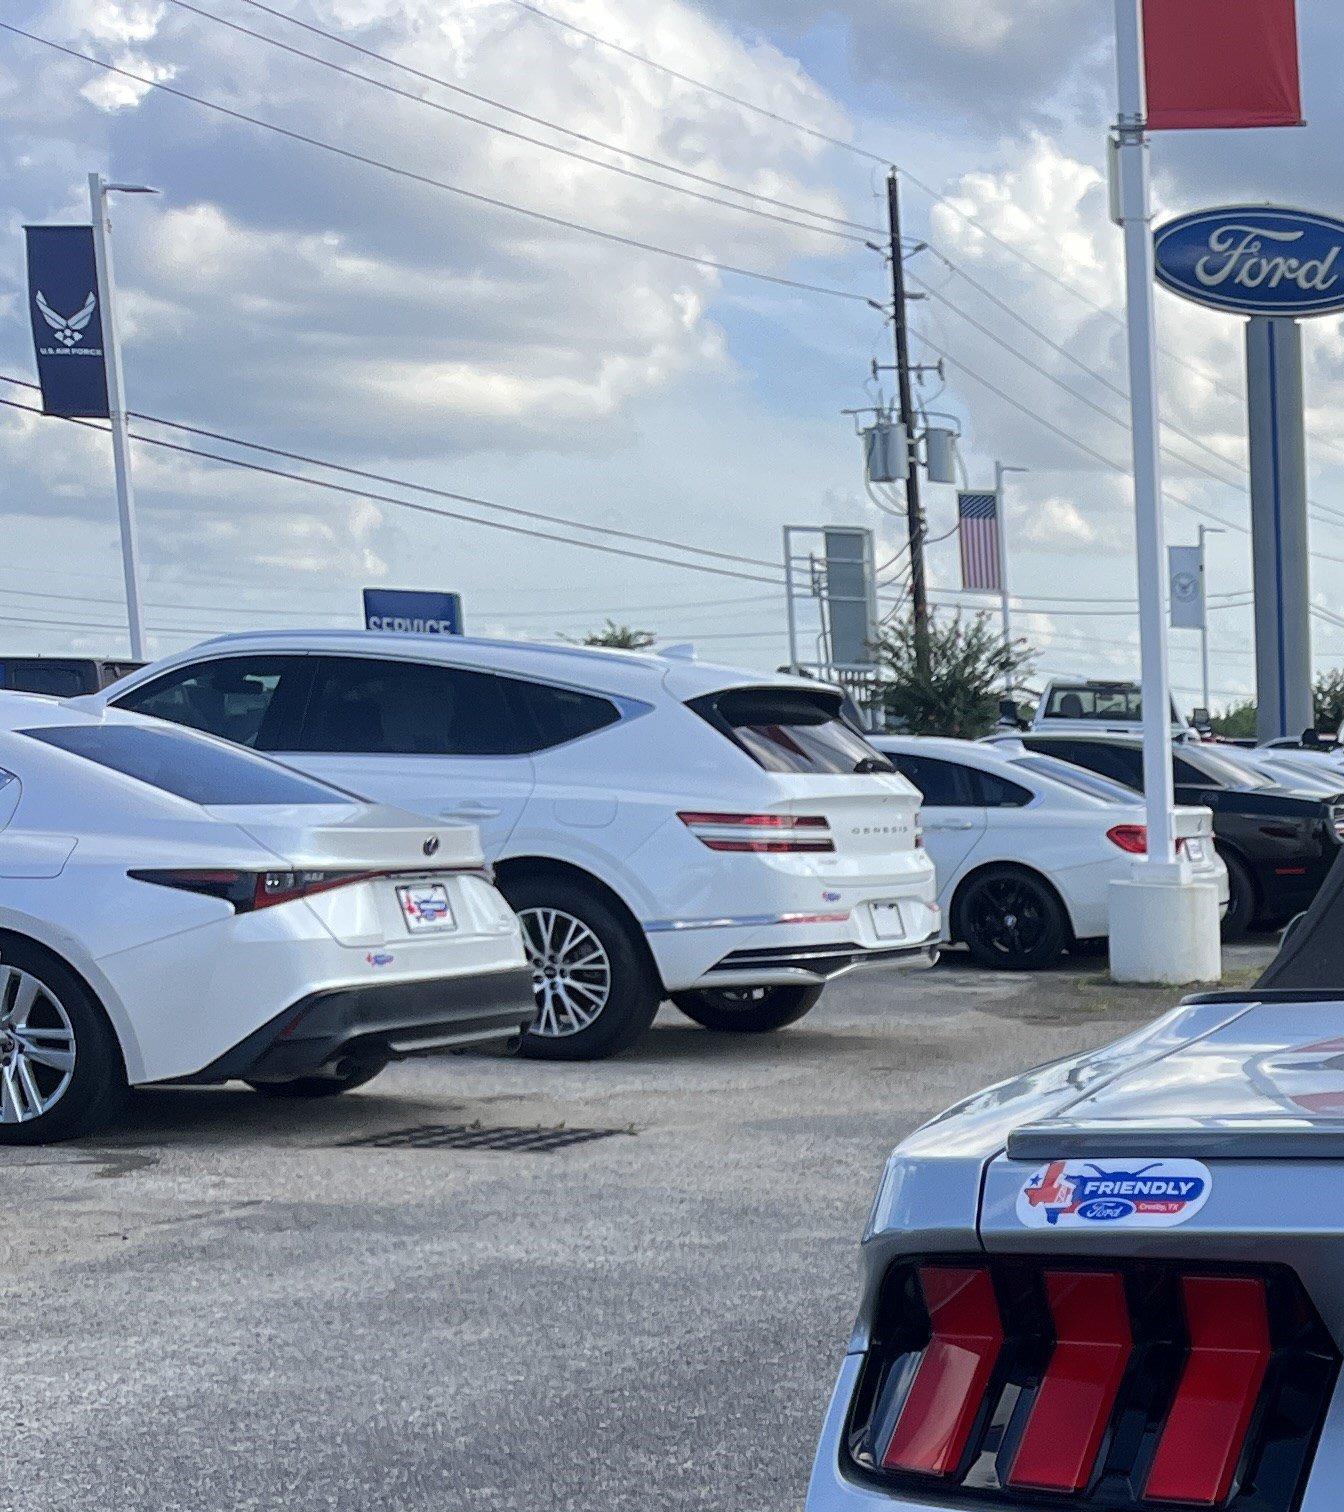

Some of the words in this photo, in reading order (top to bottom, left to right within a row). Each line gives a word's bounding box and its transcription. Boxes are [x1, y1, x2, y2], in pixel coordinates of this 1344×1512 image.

[1195, 224, 1342, 291] Ford
[1084, 1180, 1195, 1195] FRIENDLY
[1086, 1202, 1124, 1218] Ford
